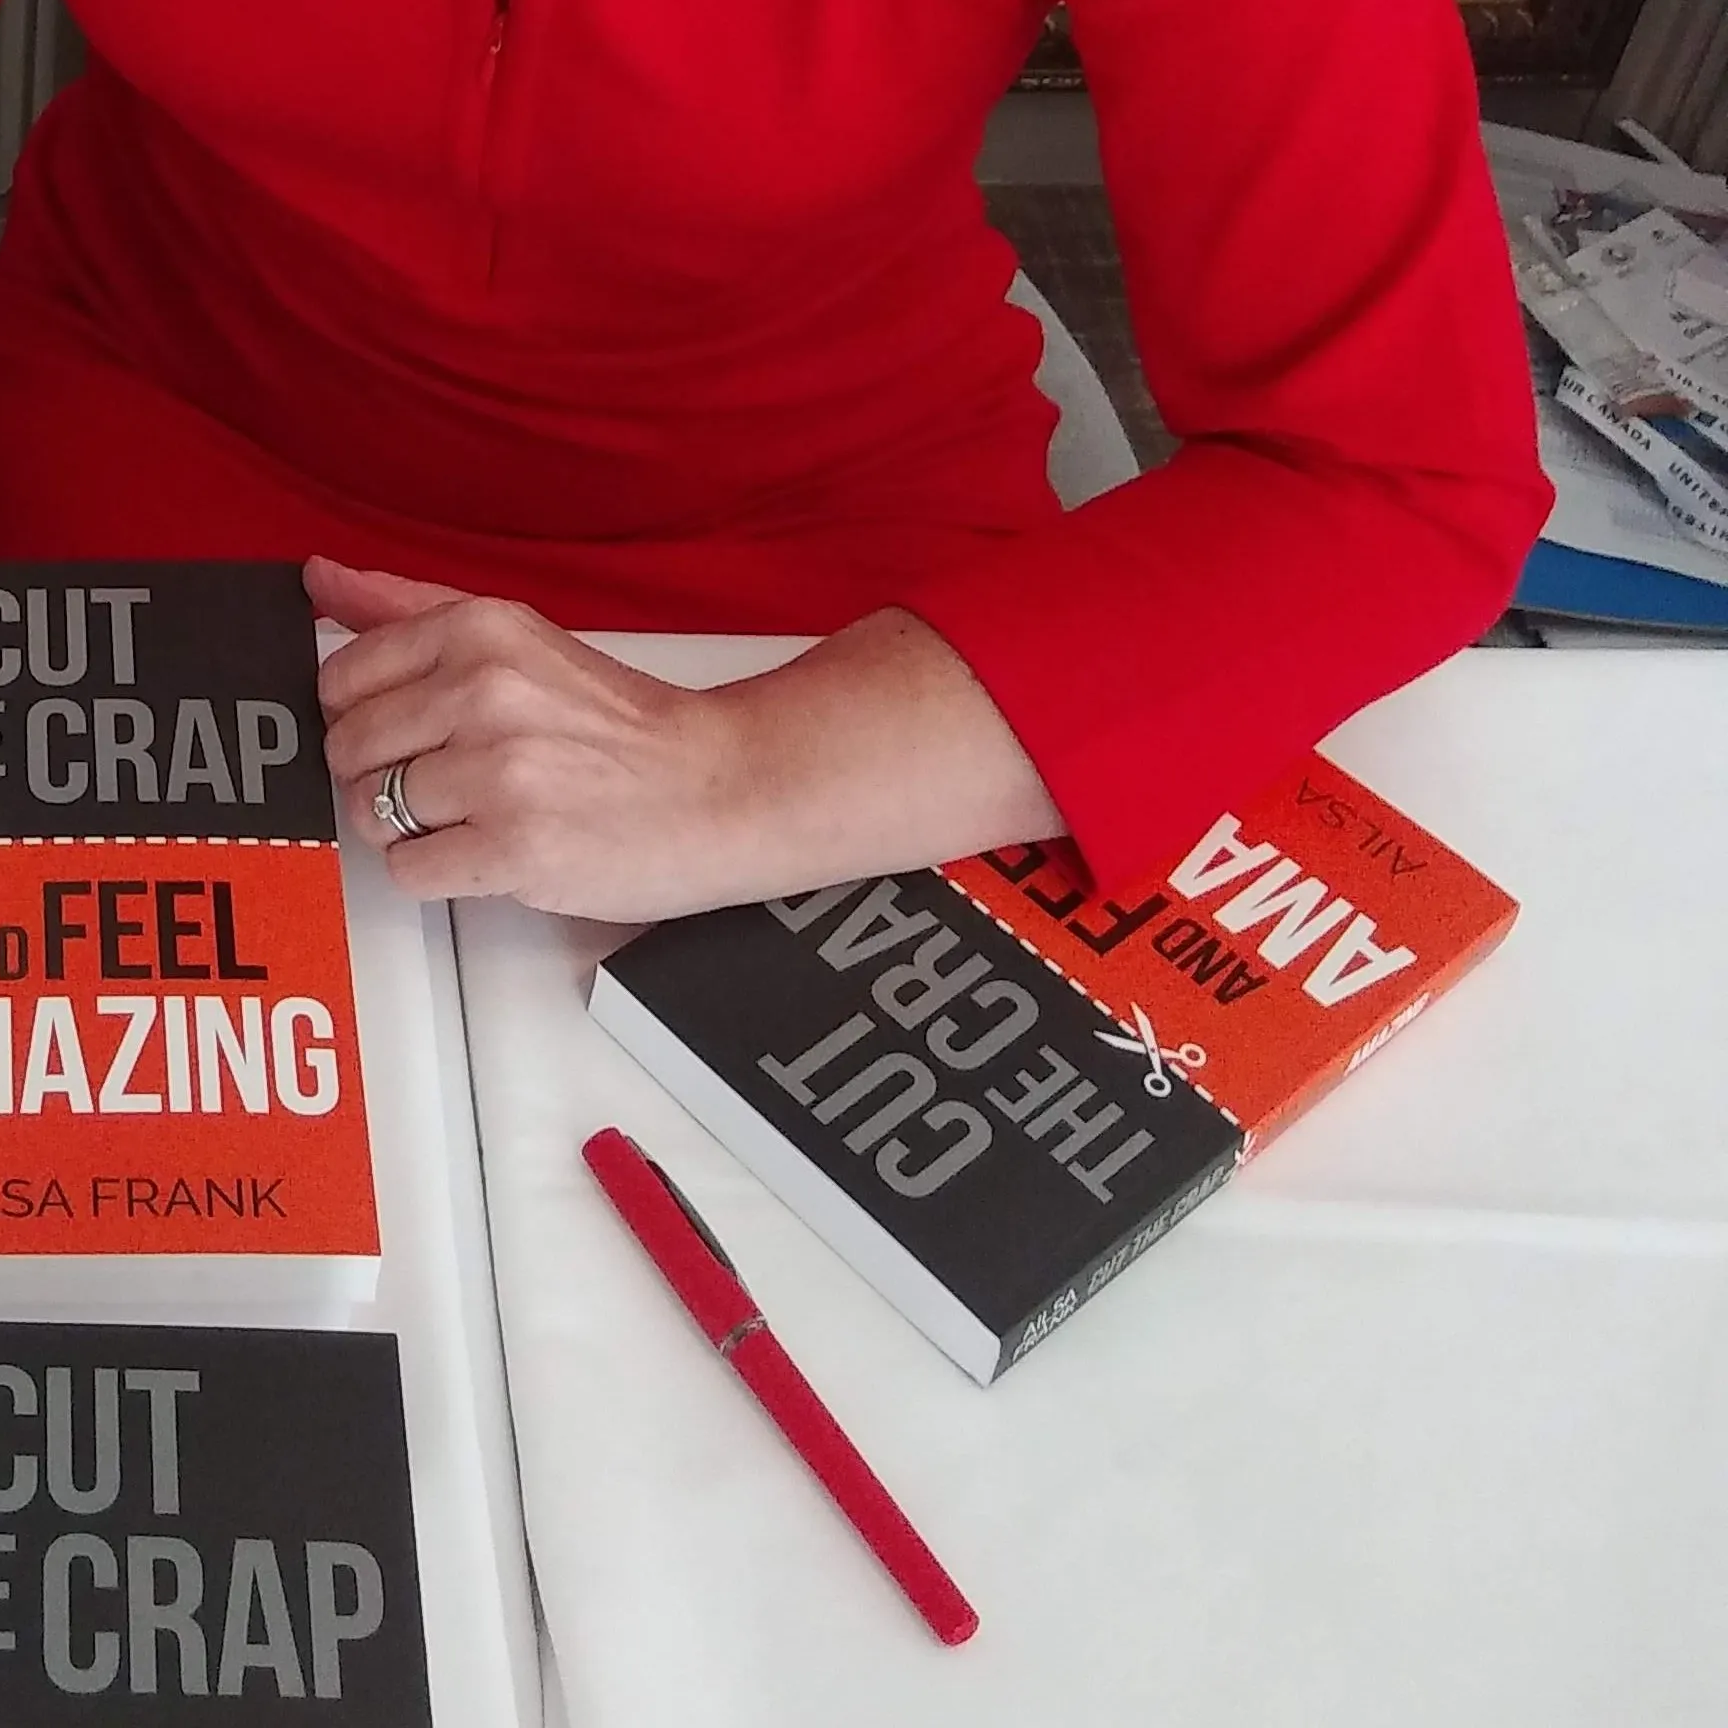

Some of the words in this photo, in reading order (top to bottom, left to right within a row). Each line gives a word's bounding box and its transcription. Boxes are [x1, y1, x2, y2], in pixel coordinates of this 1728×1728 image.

[1587, 393, 1652, 452] CANADA
[25, 697, 299, 806] CRAP
[42, 880, 269, 981] FEEL
[1151, 917, 1271, 1005] AND
[756, 1011, 994, 1197] CUT
[984, 1044, 1156, 1205] THE
[91, 1178, 287, 1218] FRANK
[42, 1532, 385, 1700] CRAP
